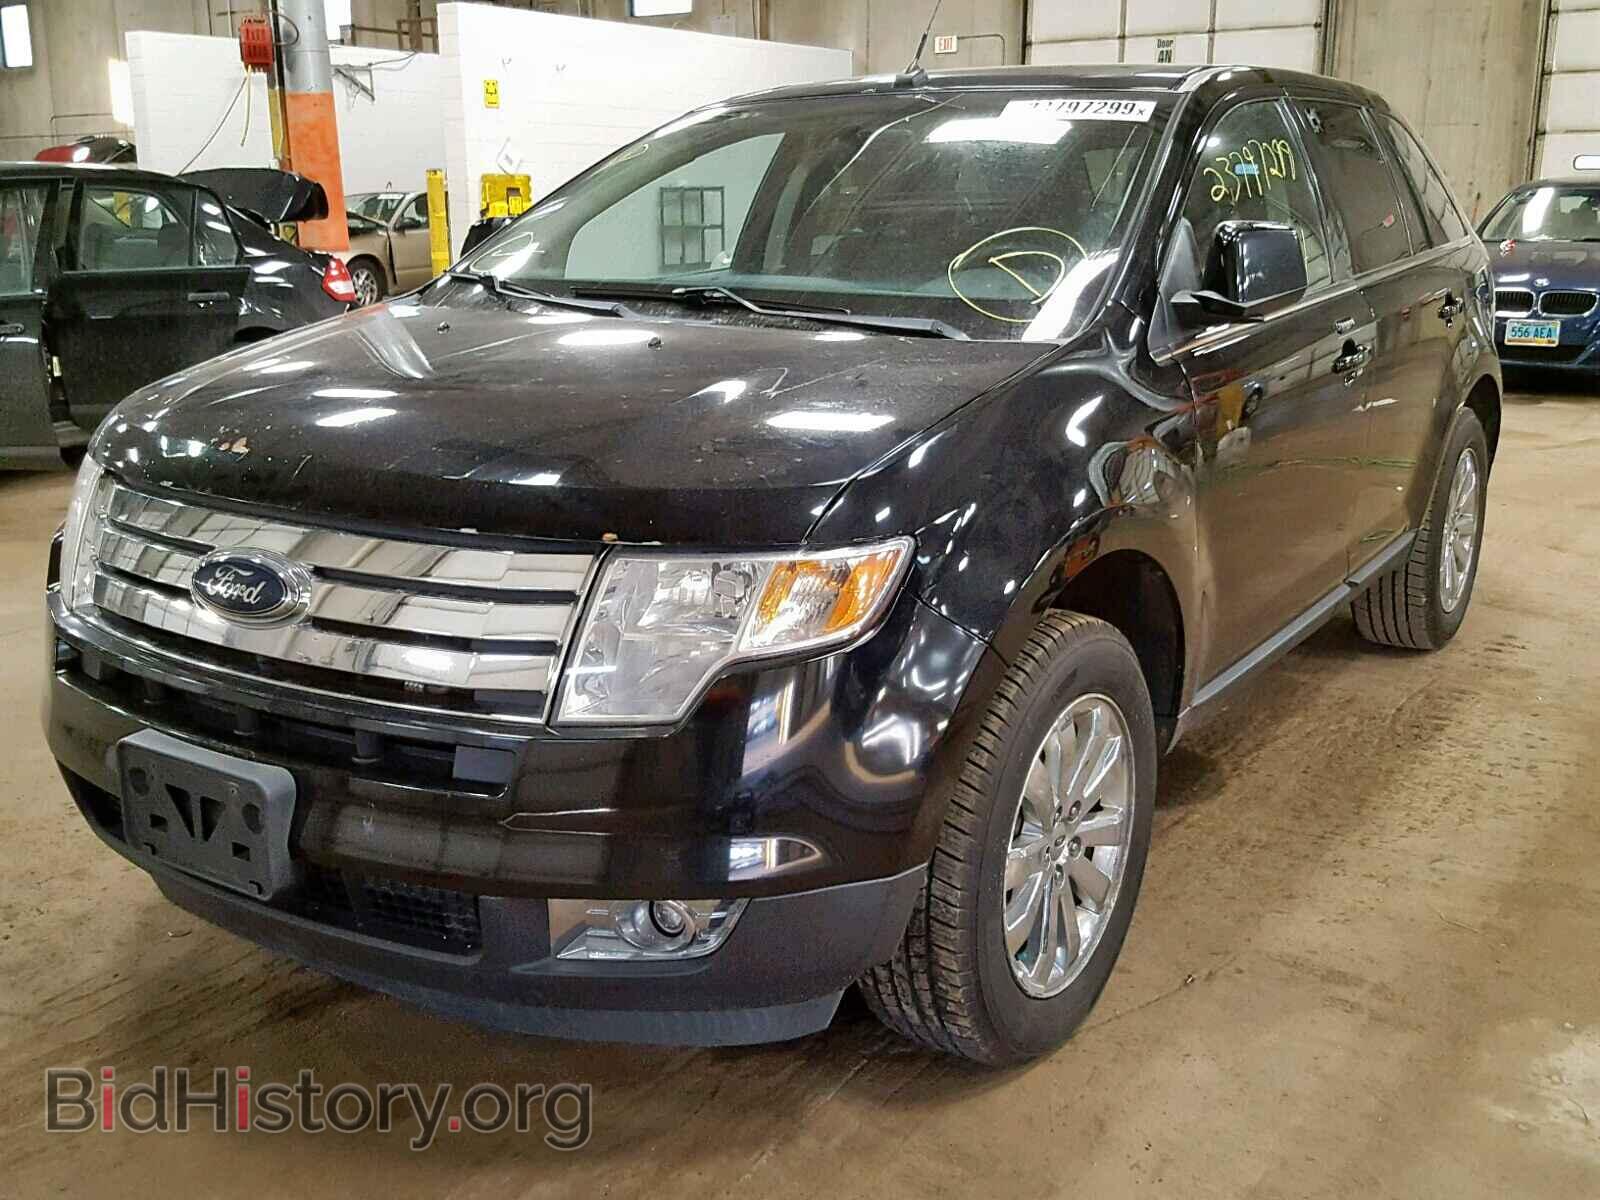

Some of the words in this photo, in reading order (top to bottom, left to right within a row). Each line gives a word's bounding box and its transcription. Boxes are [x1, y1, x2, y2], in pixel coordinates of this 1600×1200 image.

[938, 37, 953, 50] EXIT
[1157, 39, 1174, 48] Door
[1511, 326, 1530, 338] 556
[1533, 327, 1552, 338] AEA
[206, 564, 267, 605] Ford
